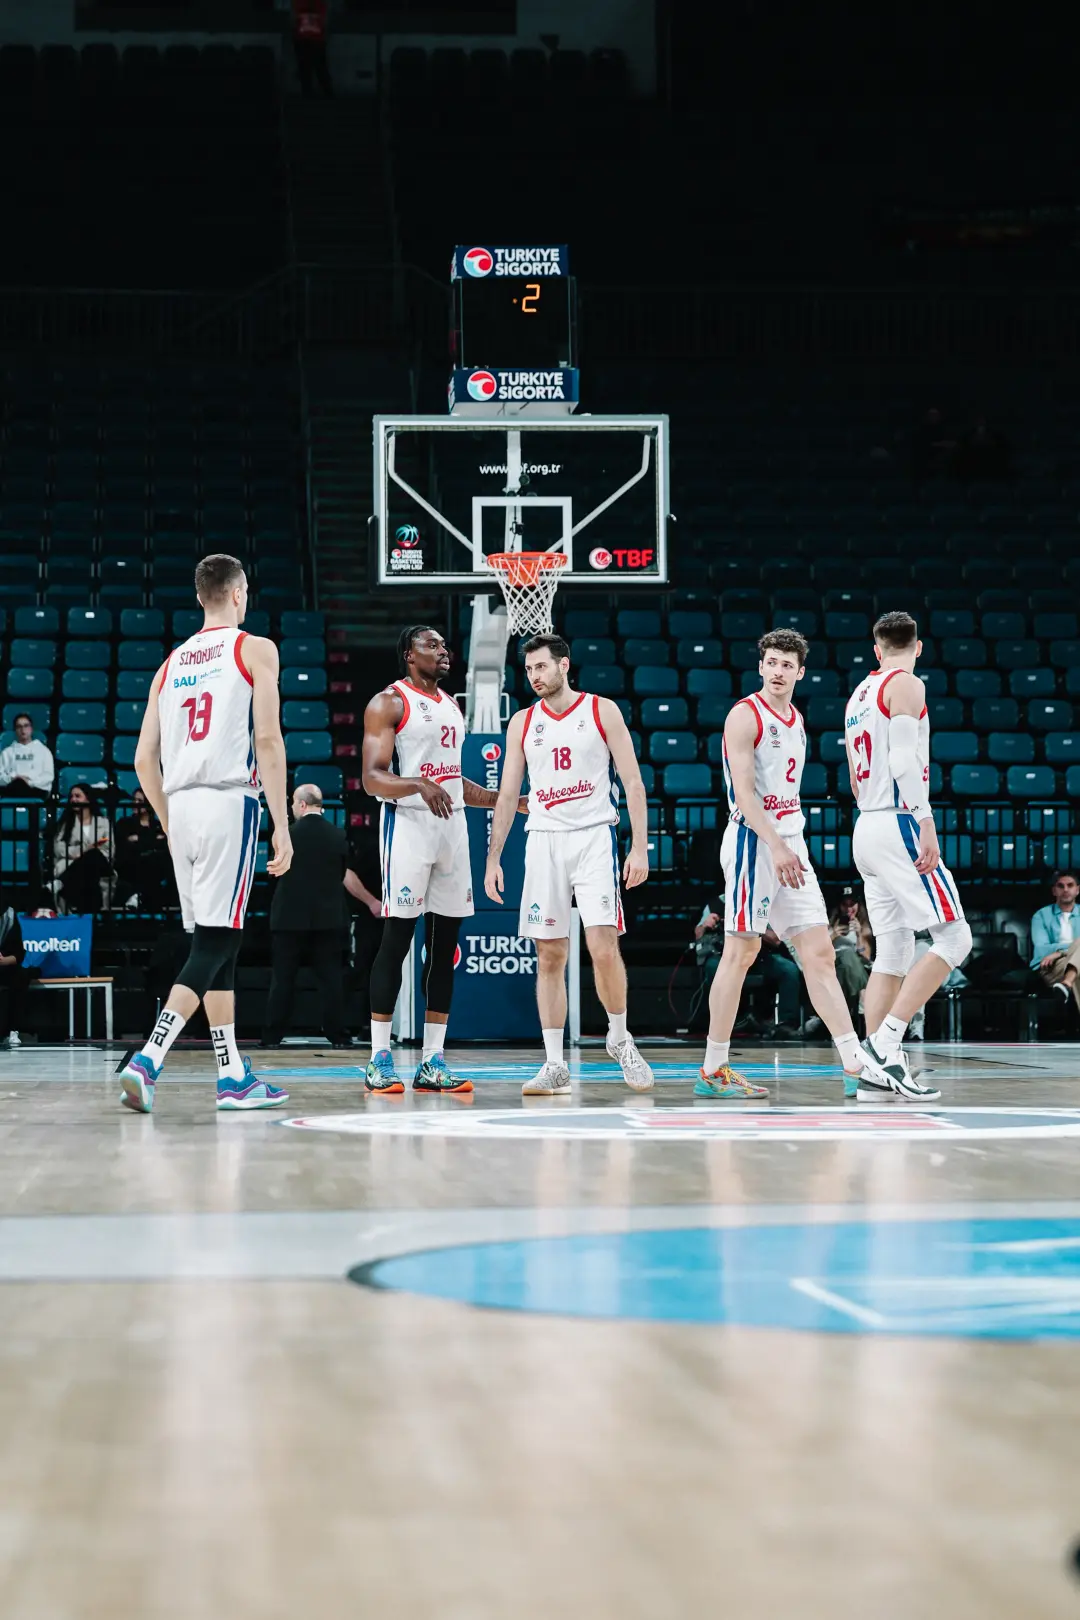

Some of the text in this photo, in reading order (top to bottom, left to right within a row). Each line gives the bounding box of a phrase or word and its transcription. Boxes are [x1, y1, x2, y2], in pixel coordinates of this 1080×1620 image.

[613, 549, 653, 568] TBF
[173, 675, 197, 689] BAU
[440, 725, 457, 749] 21
[551, 746, 572, 771] 18
[785, 757, 796, 784] 2
[397, 897, 415, 905] BAU
[22, 937, 81, 953] molten
